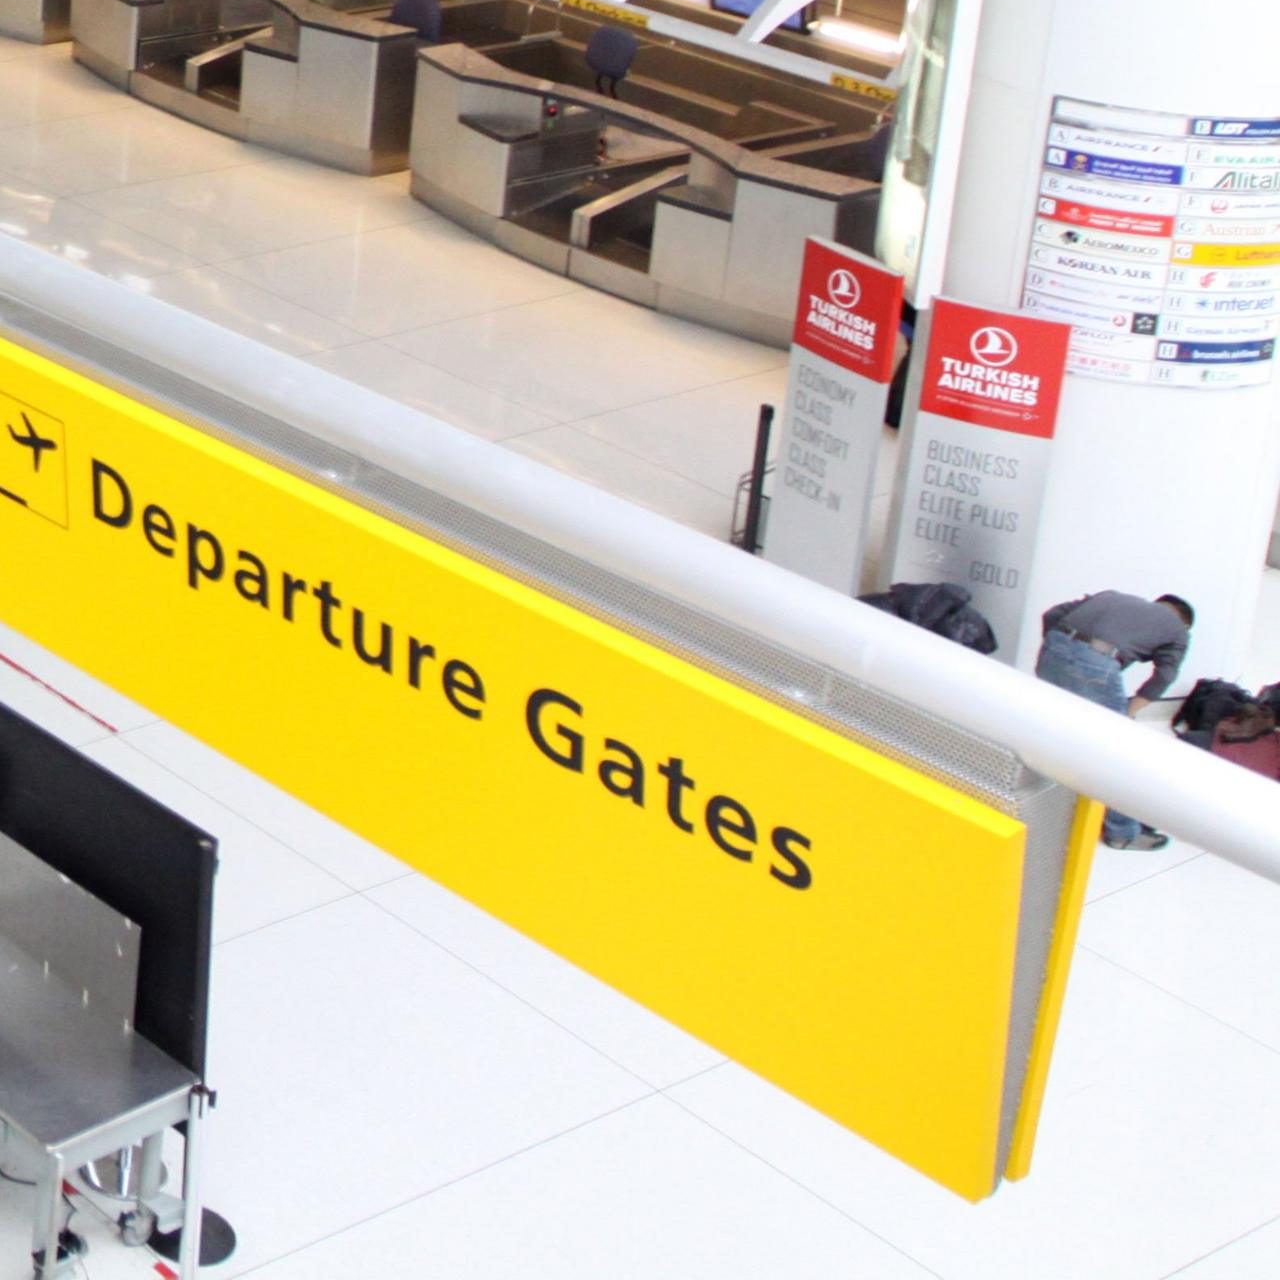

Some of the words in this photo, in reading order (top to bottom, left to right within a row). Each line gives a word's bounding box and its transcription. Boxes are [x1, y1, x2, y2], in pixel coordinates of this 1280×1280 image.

[1055, 129, 1067, 142] A
[1050, 150, 1063, 165] A
[1082, 237, 1159, 257] AEROMEXICO
[1057, 255, 1118, 276] KOREAN
[1123, 264, 1153, 281] AIR
[1171, 270, 1184, 283] H
[809, 294, 877, 337] TURKISH
[1169, 296, 1182, 309] H
[806, 310, 875, 352] AIRLINES
[1166, 320, 1179, 333] H
[1161, 344, 1174, 358] H
[797, 363, 857, 411] ECONOMY
[941, 356, 1041, 392] TURKISH
[1158, 367, 1170, 379] H
[794, 387, 833, 427] CLASS
[937, 373, 1039, 408] AIRLINES
[790, 415, 850, 460] COMFORT
[787, 440, 827, 480] CLASS
[927, 439, 1020, 481] BUSINESS
[782, 464, 841, 513] CHECK-IN
[922, 464, 982, 498] CLASS
[918, 490, 967, 524] ELITE
[968, 502, 1020, 534] PLUS
[914, 516, 961, 549] ELITE
[968, 560, 1020, 591] GOLD
[90, 458, 487, 722] Departure
[526, 687, 815, 892] Gates
